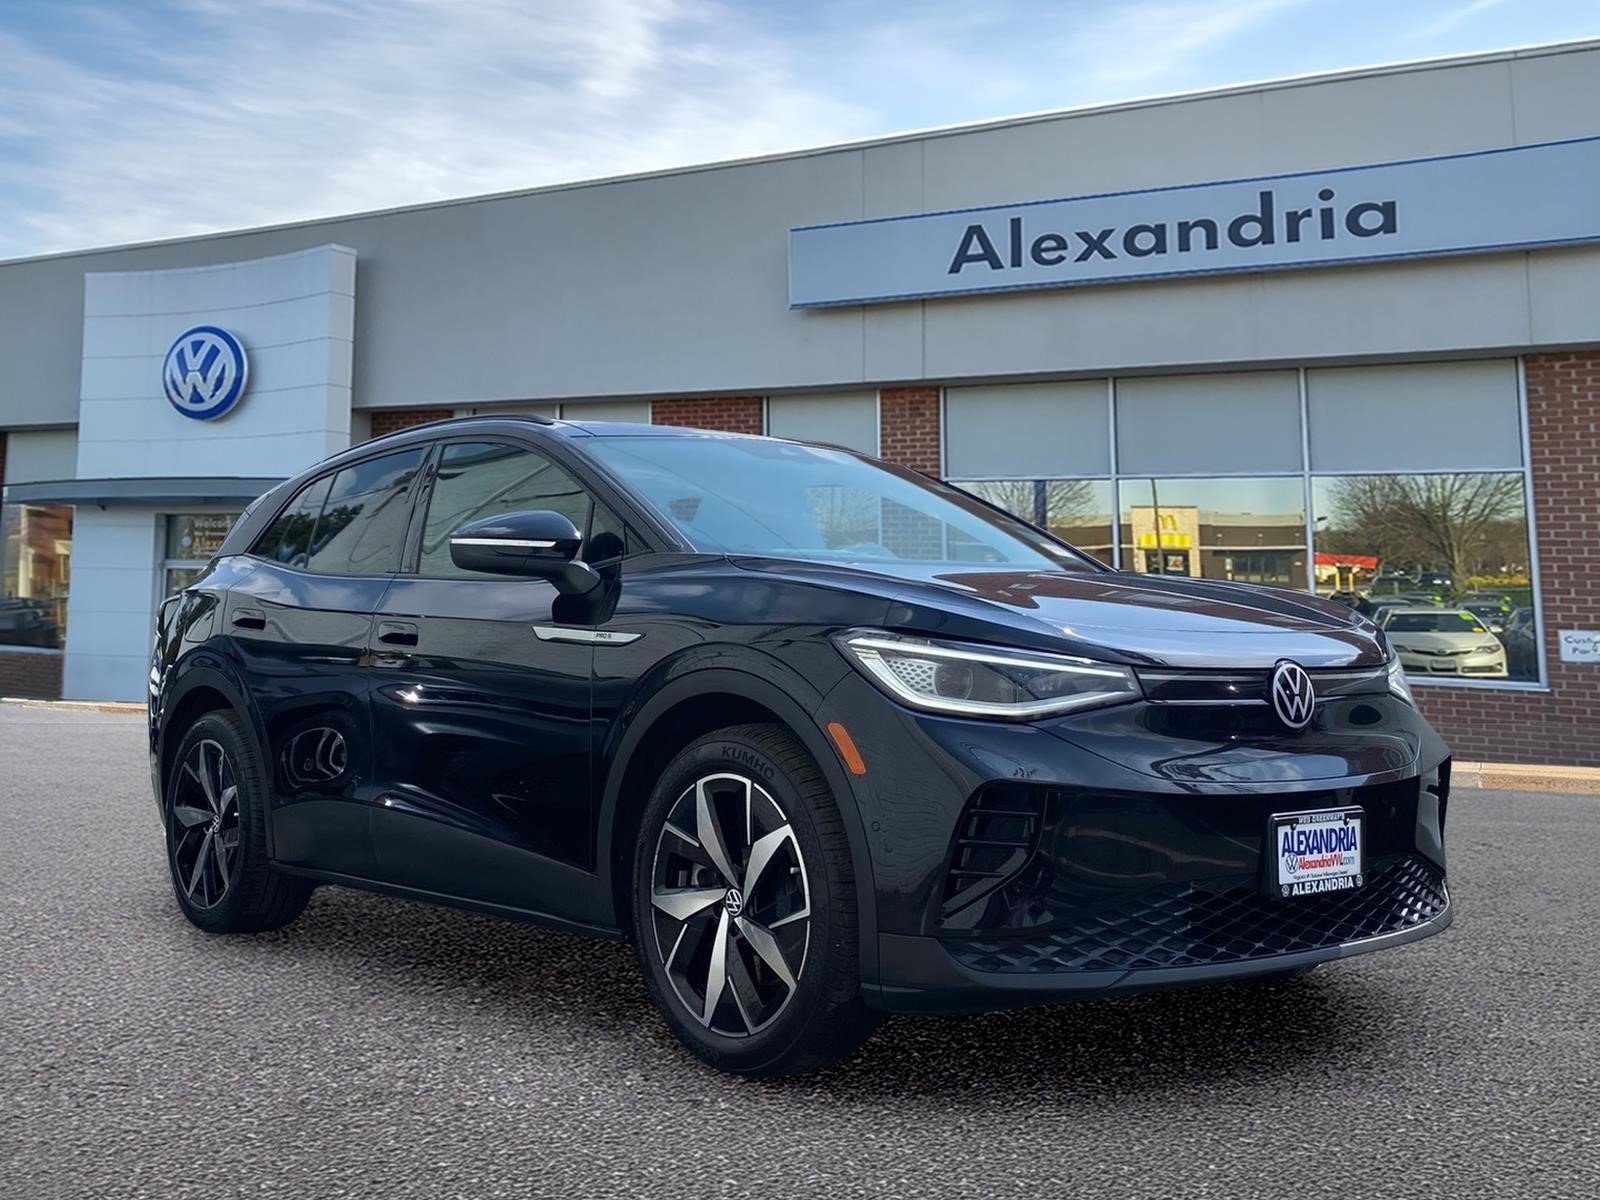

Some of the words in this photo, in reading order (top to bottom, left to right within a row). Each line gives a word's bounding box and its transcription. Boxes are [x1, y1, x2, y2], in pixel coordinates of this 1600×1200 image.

[947, 188, 1398, 275] Alexandria
[721, 745, 775, 779] KUMHO
[1281, 826, 1358, 857] ALEXANDRIA
[1292, 876, 1354, 896] ALEXANDRIA
